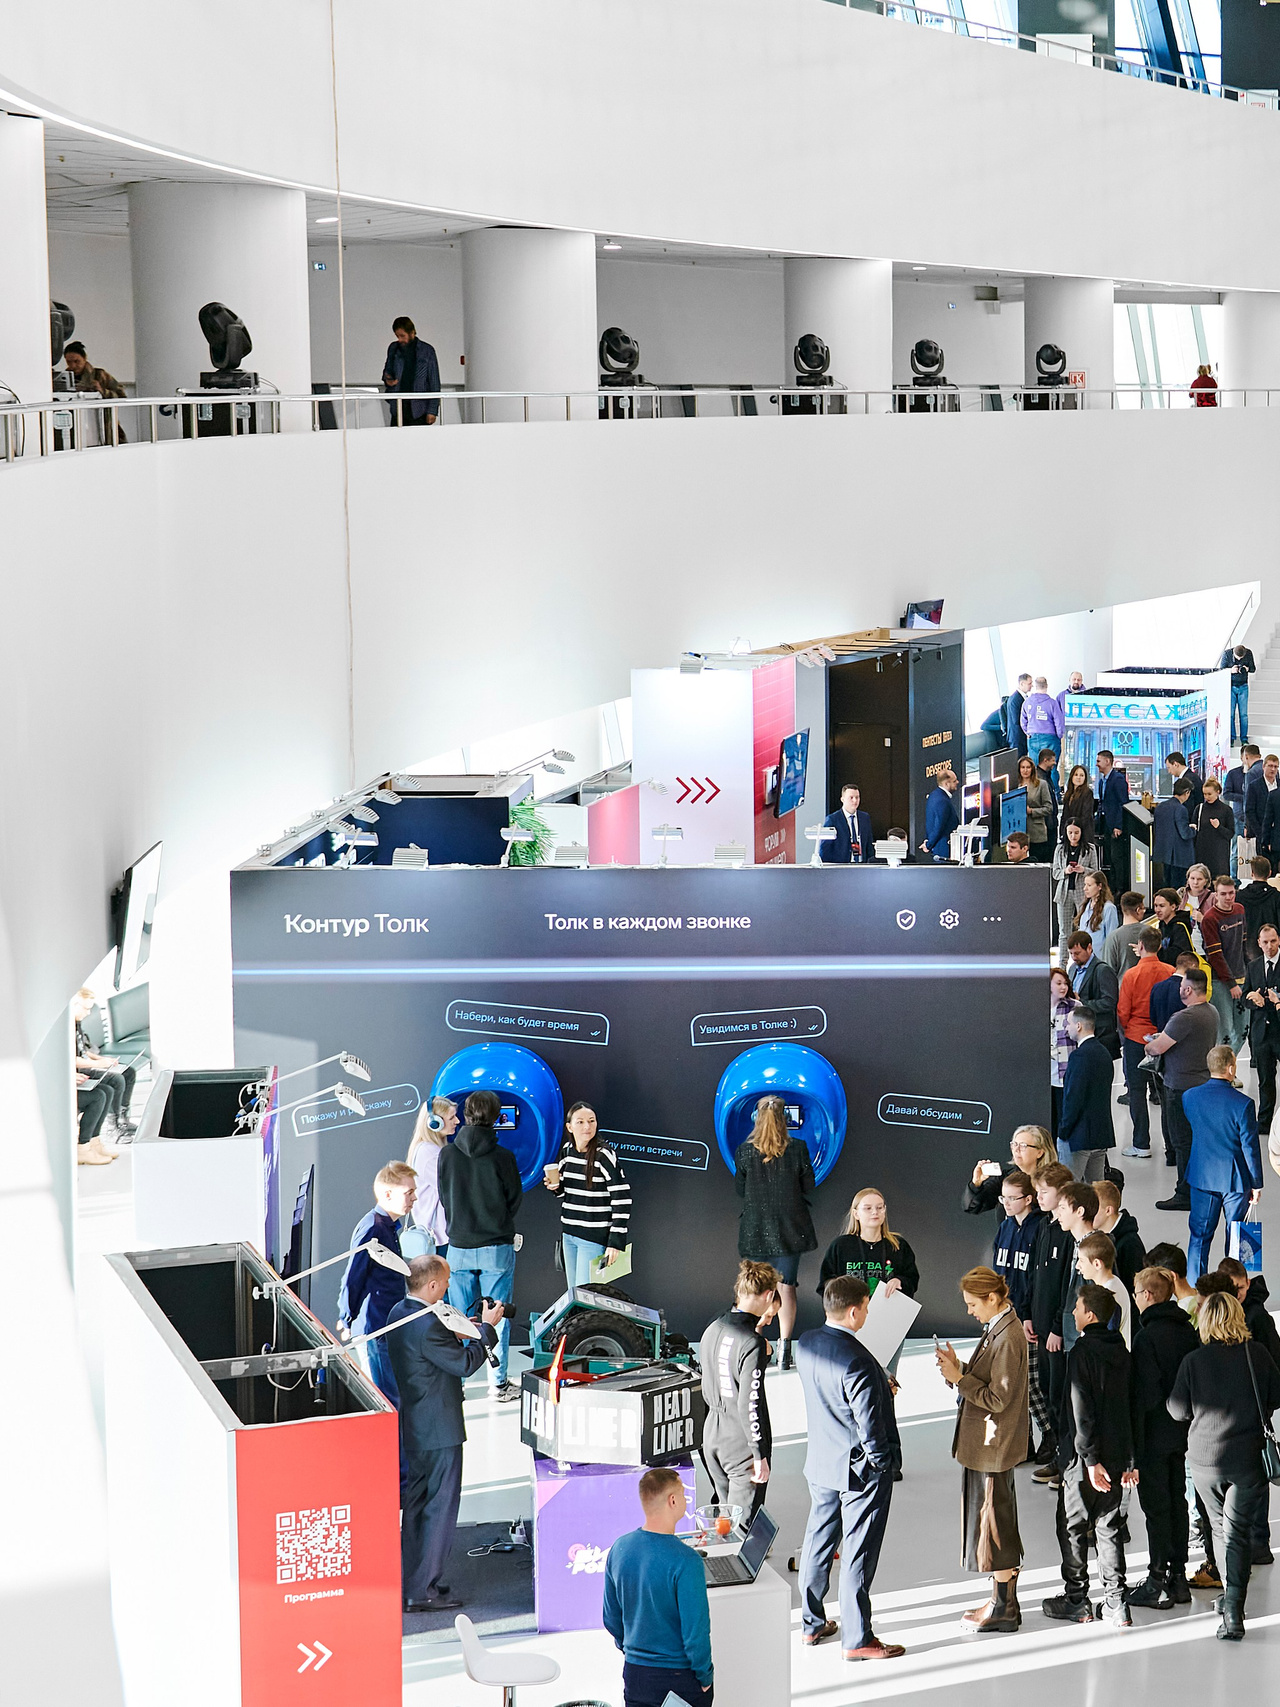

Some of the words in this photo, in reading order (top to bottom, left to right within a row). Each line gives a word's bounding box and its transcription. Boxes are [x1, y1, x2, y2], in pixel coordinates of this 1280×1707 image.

[1065, 702, 1182, 720] ПАССАЖ
[284, 914, 369, 937] Контур
[375, 913, 429, 933] Толк
[544, 913, 588, 930] Толк
[593, 916, 603, 930] в
[608, 916, 682, 931] каждом
[686, 915, 751, 930] звонке
[455, 1010, 496, 1024] Набери,
[498, 1016, 515, 1025] как
[517, 1016, 546, 1030] будет
[547, 1021, 580, 1031] время
[699, 1023, 750, 1035] Увидимся
[751, 1022, 758, 1030] в
[759, 1019, 788, 1030] Толке
[301, 1111, 338, 1125] Покажу
[340, 1108, 346, 1116] и
[348, 1099, 392, 1116] рскажу
[886, 1103, 918, 1116] Давай
[919, 1109, 963, 1120] обсудим
[620, 1144, 645, 1152] итоги
[646, 1147, 683, 1157] встречи
[653, 1387, 691, 1424] HEAD
[653, 1417, 694, 1456] LINER
[284, 1587, 345, 1604] Программа
